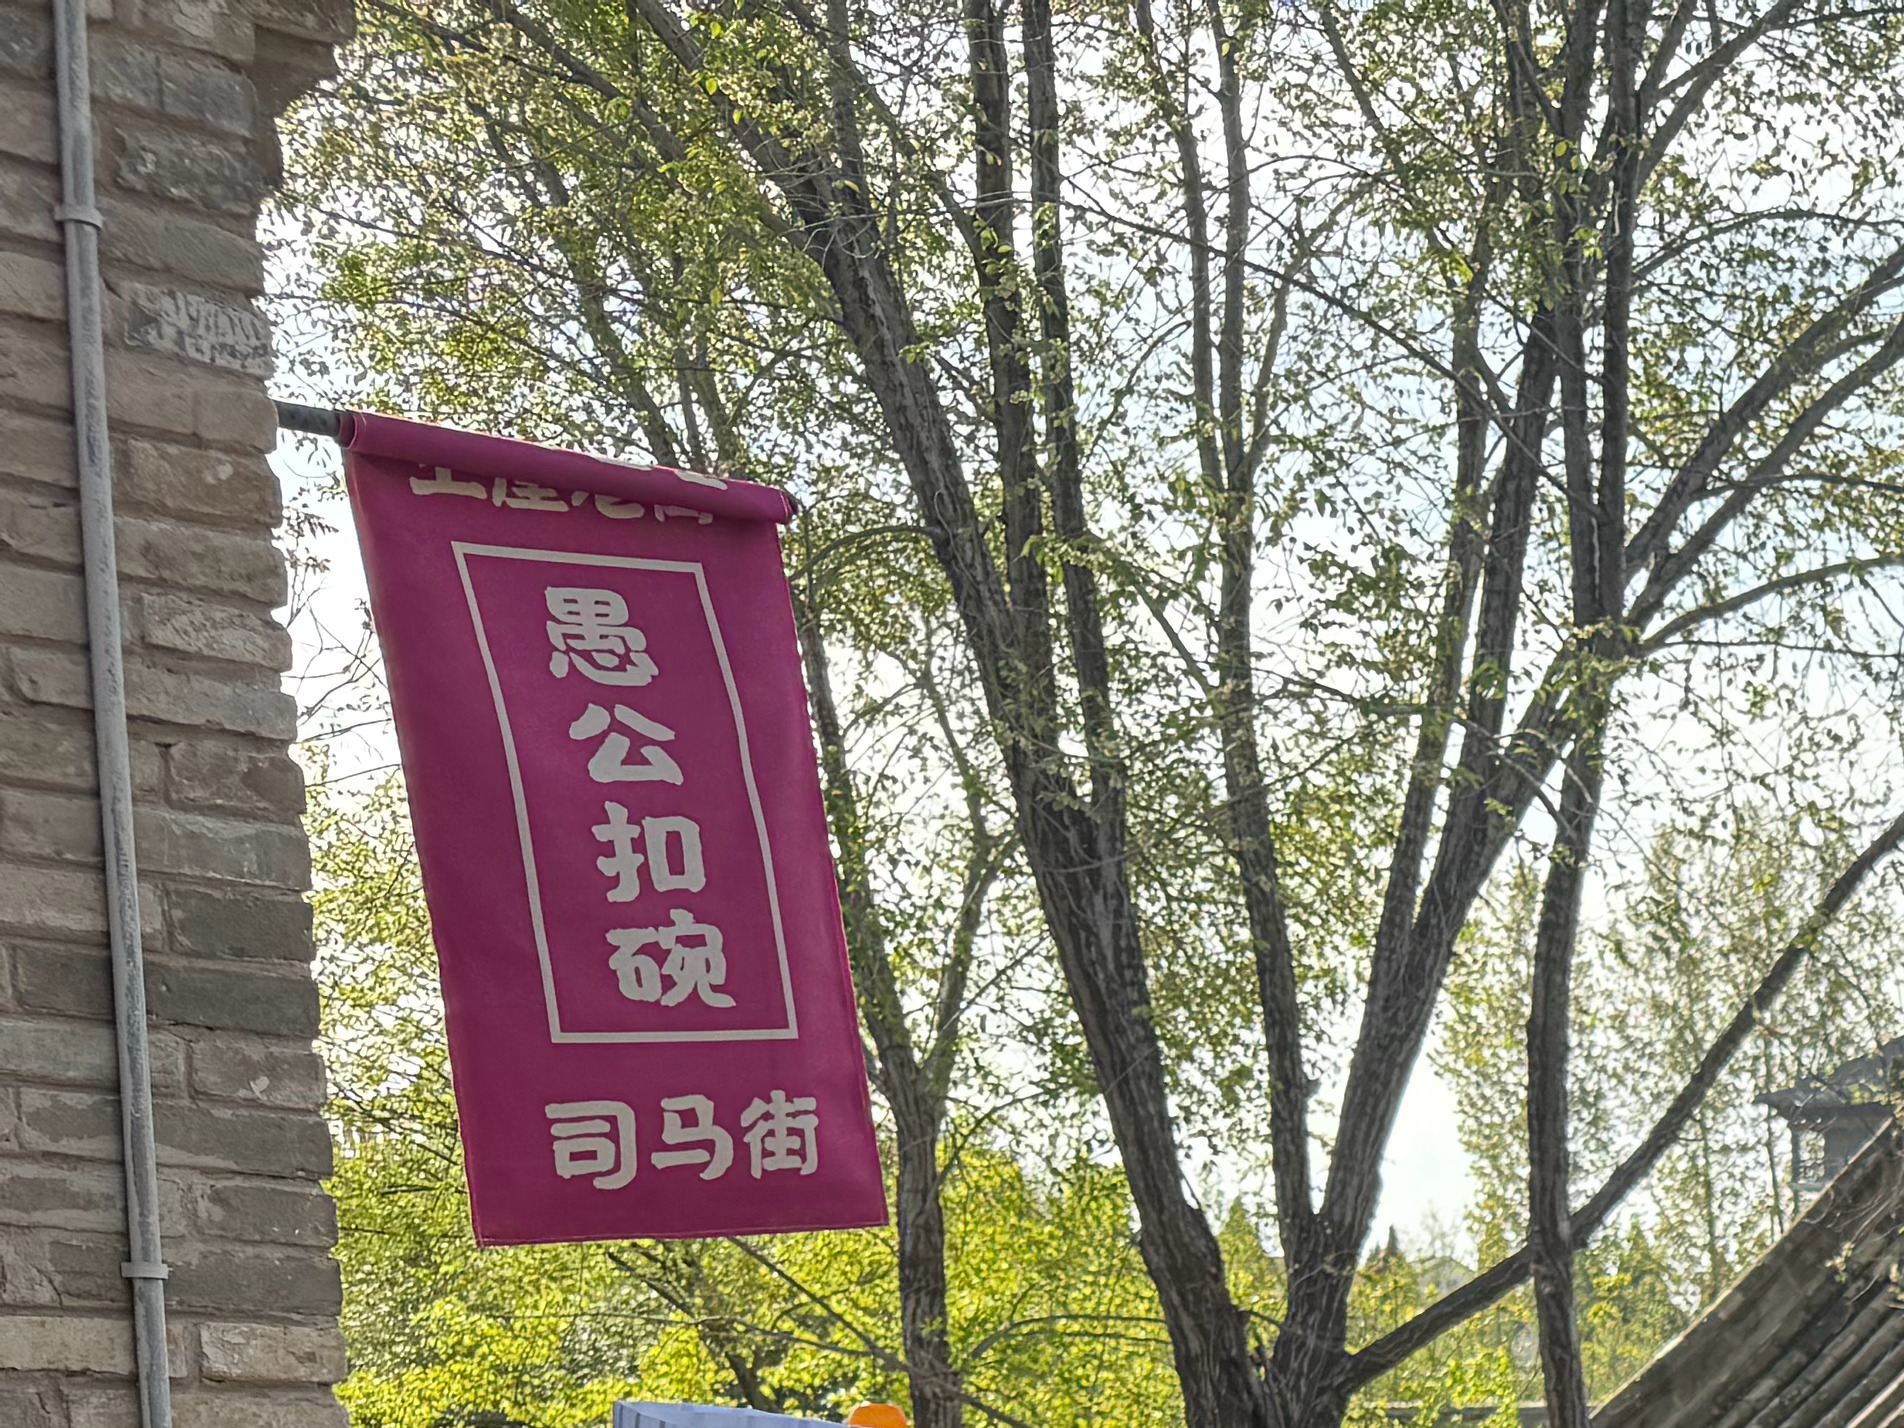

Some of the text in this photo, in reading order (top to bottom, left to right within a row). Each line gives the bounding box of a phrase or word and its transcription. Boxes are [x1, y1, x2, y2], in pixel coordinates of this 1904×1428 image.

[544, 584, 737, 1009] 愚公扣碗
[545, 1088, 820, 1192] 司马街
